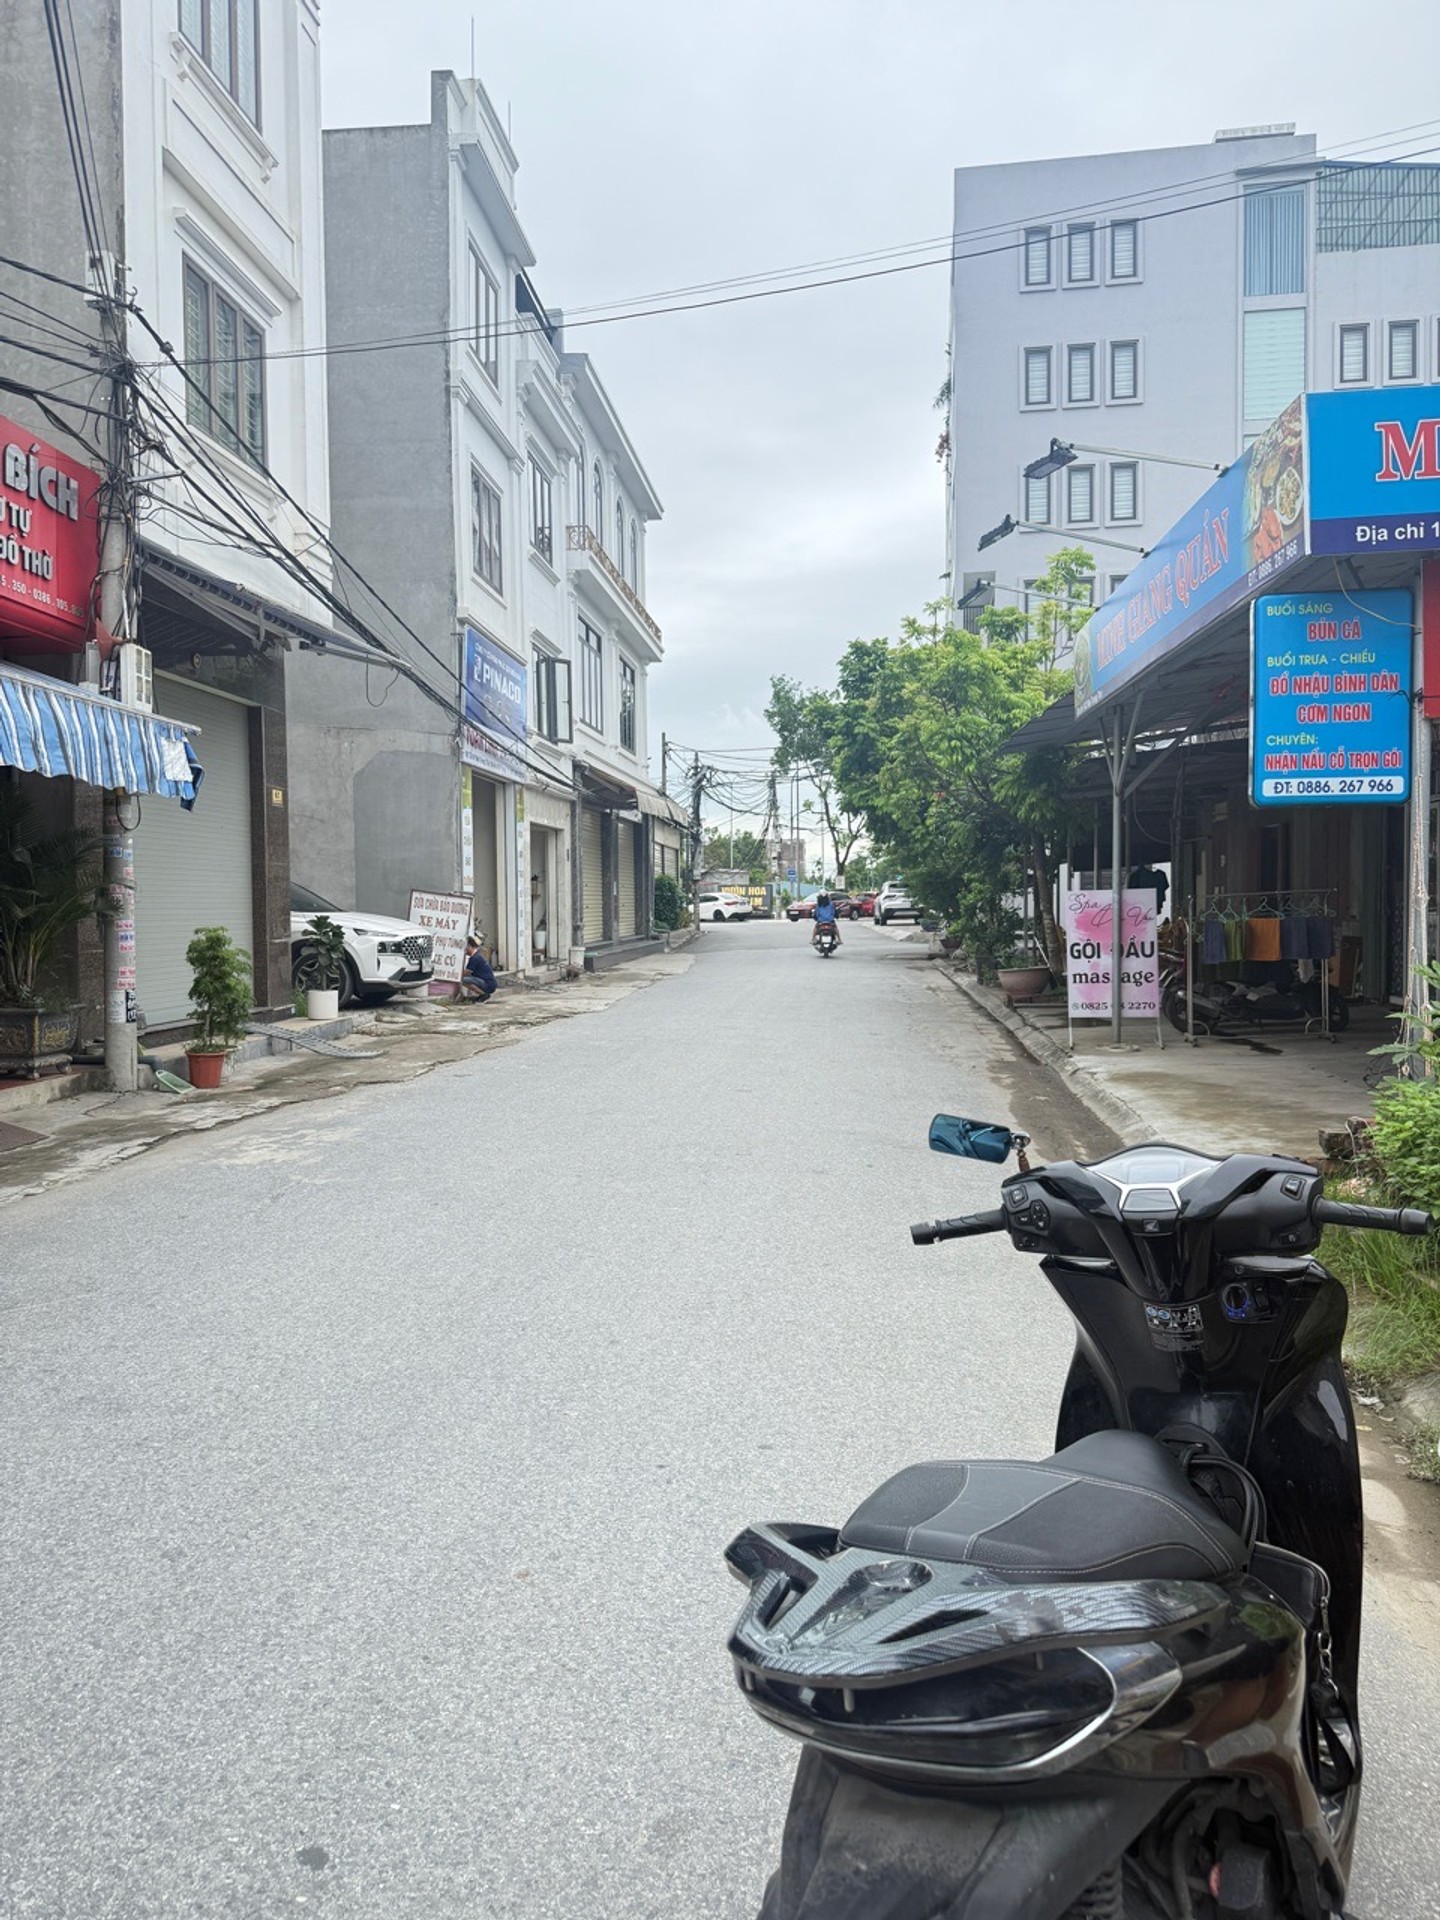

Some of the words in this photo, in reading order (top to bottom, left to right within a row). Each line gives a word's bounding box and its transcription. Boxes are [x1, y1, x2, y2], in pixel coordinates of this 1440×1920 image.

[4, 443, 78, 521] BÍCH
[1355, 525, 1388, 545] Địa
[1394, 522, 1424, 539] chỉ
[22, 545, 53, 580] THỜ
[1299, 603, 1333, 614] SÁNG
[1307, 618, 1337, 641] BÚN
[1341, 617, 1361, 639] CÁ
[1299, 653, 1328, 665] TRƯA
[482, 662, 521, 704] PINACO
[1293, 672, 1329, 698] NHẬU
[1334, 672, 1366, 693] BÌNH
[1371, 670, 1399, 691] DÂN
[1297, 704, 1328, 724] CƠM
[1332, 703, 1371, 722] NGON
[1266, 732, 1318, 746] CHUYÊN:
[1265, 751, 1297, 774] NHẬN
[1302, 747, 1325, 769] NẤU
[1349, 751, 1379, 772] TRỌN
[1274, 781, 1292, 794] ĐT:
[1297, 780, 1334, 794] 0886.
[1339, 779, 1363, 793] 267
[1368, 779, 1393, 792] 966
[748, 886, 766, 896] HOA
[419, 914, 433, 926] XE
[435, 915, 458, 930] MÁY
[1070, 938, 1101, 963] GỘI
[1072, 970, 1155, 987] masage
[1081, 1002, 1108, 1010] 0825
[1128, 1001, 1156, 1010] 2270
